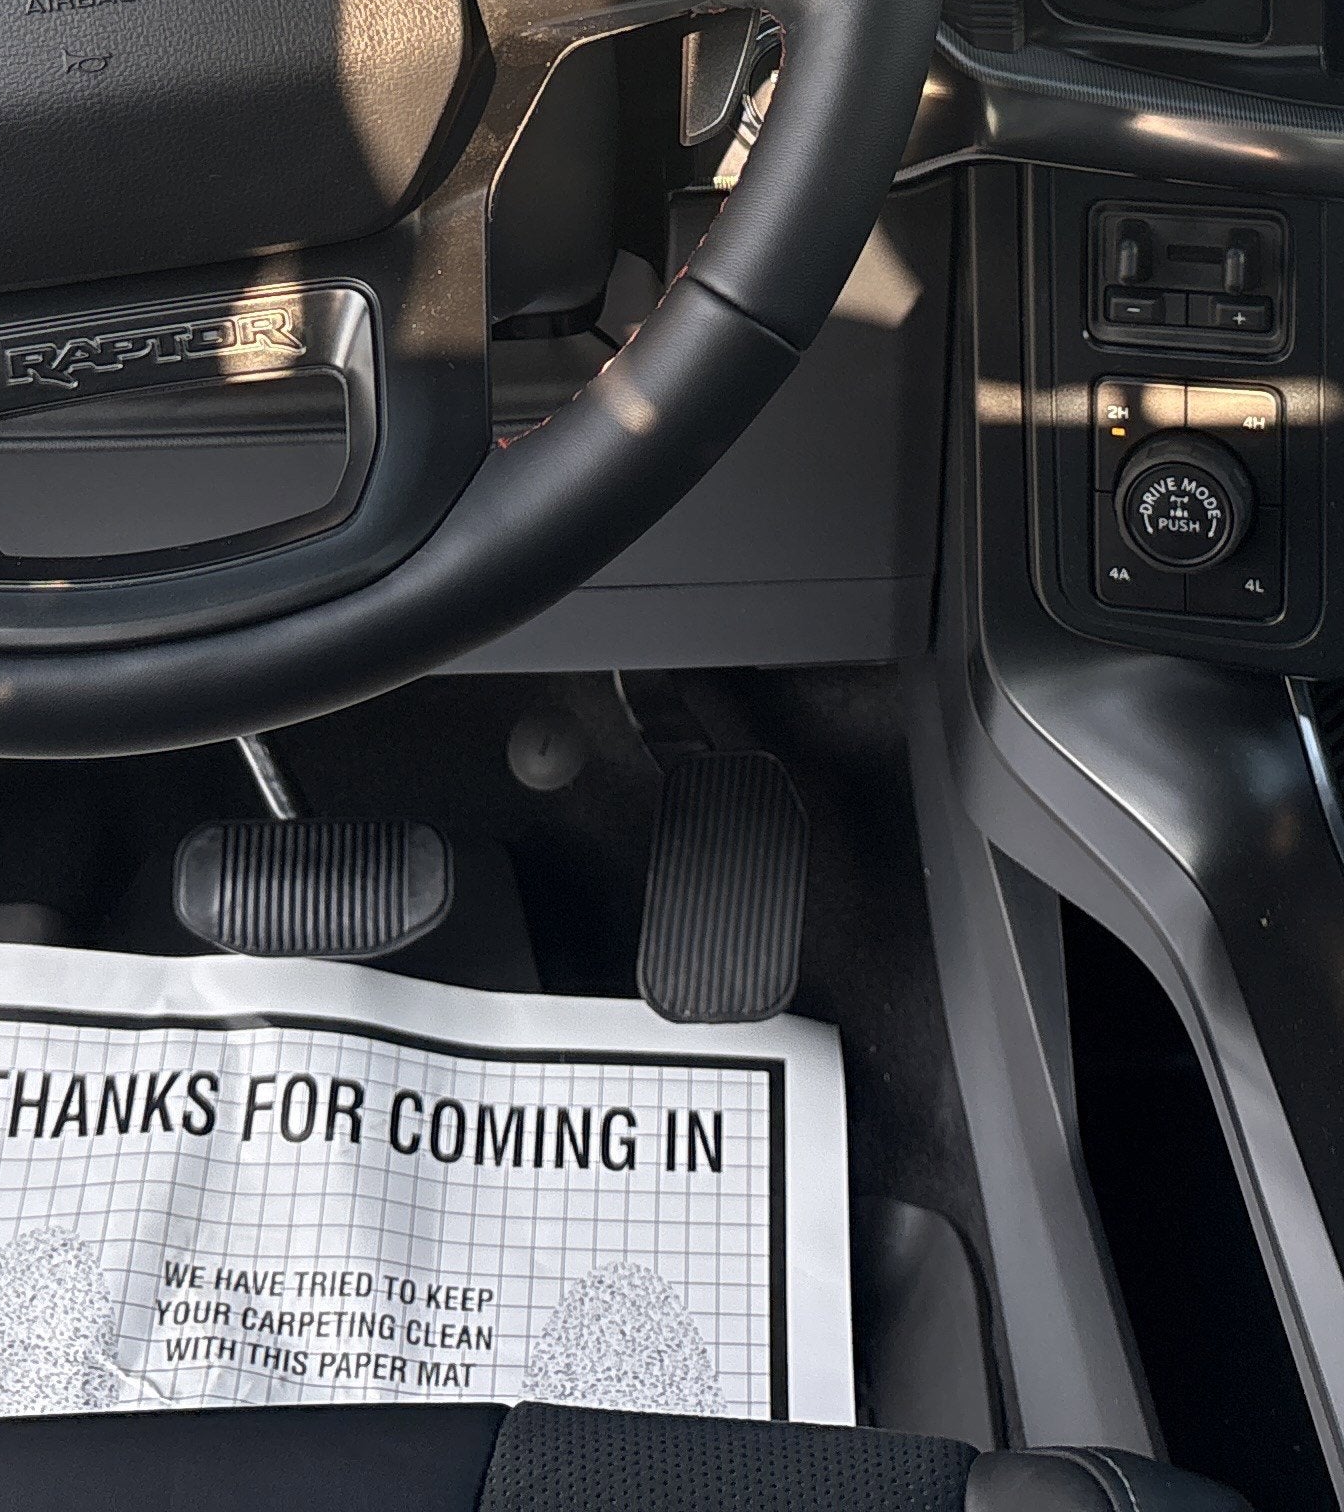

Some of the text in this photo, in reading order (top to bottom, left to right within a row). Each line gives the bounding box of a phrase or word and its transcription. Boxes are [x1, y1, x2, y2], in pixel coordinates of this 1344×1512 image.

[6, 307, 308, 389] RAPTOR
[1108, 405, 1129, 419] 2H
[1243, 416, 1265, 430] 4H
[1139, 477, 1221, 519] DRIVE MODE
[1158, 517, 1200, 533] PUSH
[1109, 567, 1130, 581] 4A
[1244, 579, 1264, 593] 4L
[241, 1072, 365, 1144] FOR
[389, 1088, 637, 1173] COMING
[665, 1108, 723, 1173] IN
[164, 1260, 494, 1313] WE HAVE TRIED TO KEEP
[155, 1299, 493, 1351] YOUR CARPETING CLEAN
[166, 1337, 476, 1389] WITH THIS PAPER MAT
